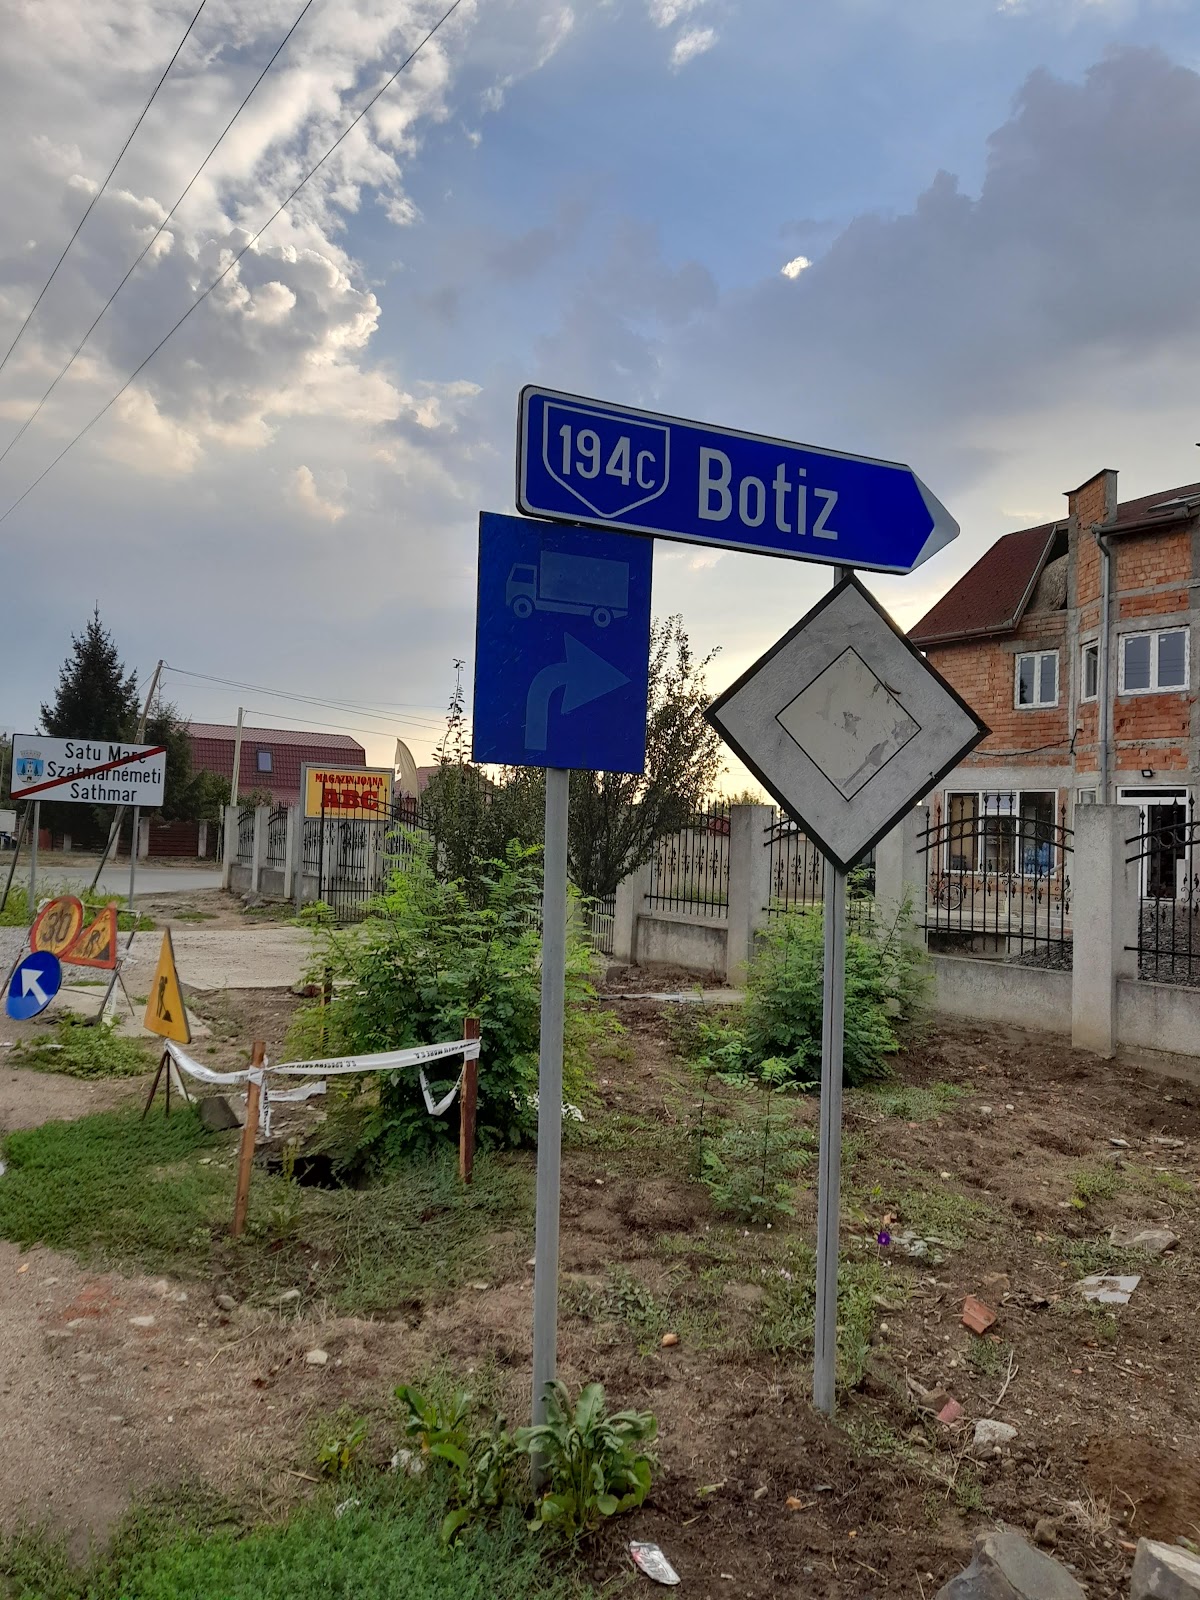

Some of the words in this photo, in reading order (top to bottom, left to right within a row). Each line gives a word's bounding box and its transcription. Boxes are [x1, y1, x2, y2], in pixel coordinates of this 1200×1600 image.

[698, 446, 839, 541] Botiz
[65, 742, 101, 760] Satu
[315, 773, 354, 784] MAGAZIN
[70, 783, 137, 802] Sathmar
[321, 788, 378, 809] ABC
[42, 911, 72, 943] 30
